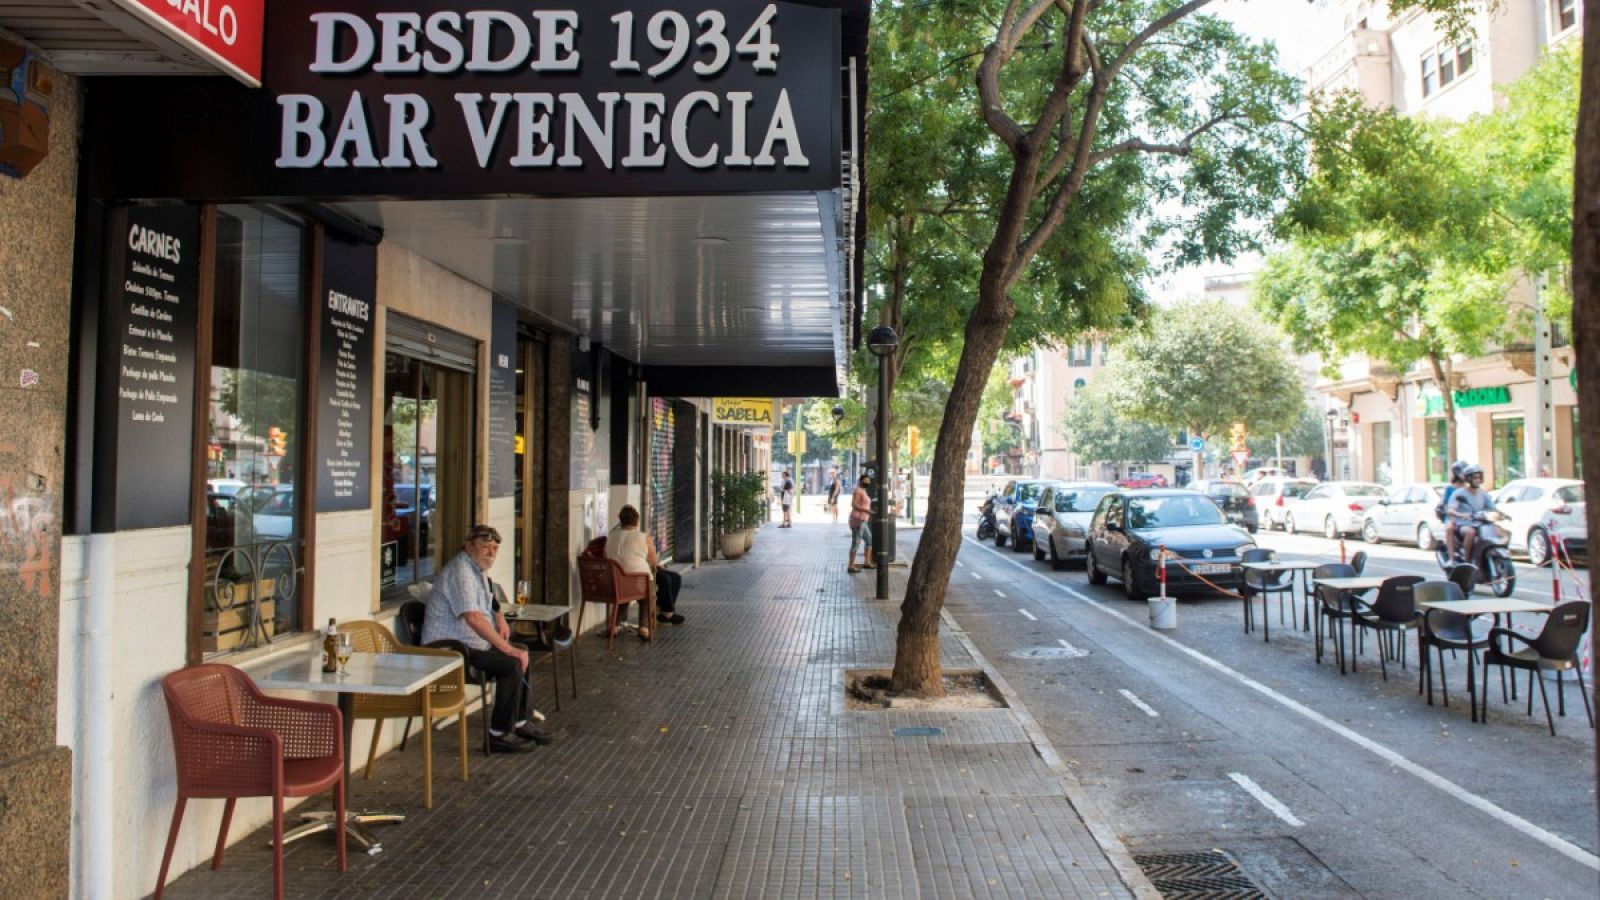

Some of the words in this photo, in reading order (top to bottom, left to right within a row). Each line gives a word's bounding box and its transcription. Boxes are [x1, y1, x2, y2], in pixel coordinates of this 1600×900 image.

[167, 0, 237, 46] ALO
[309, 10, 581, 75] DESDE
[609, 3, 781, 77] 1934
[275, 92, 439, 170] BAR
[453, 88, 811, 170] VENECIA
[128, 223, 181, 265] CARNES
[327, 289, 369, 321] ENTRANTES
[716, 407, 772, 422] SABELA
